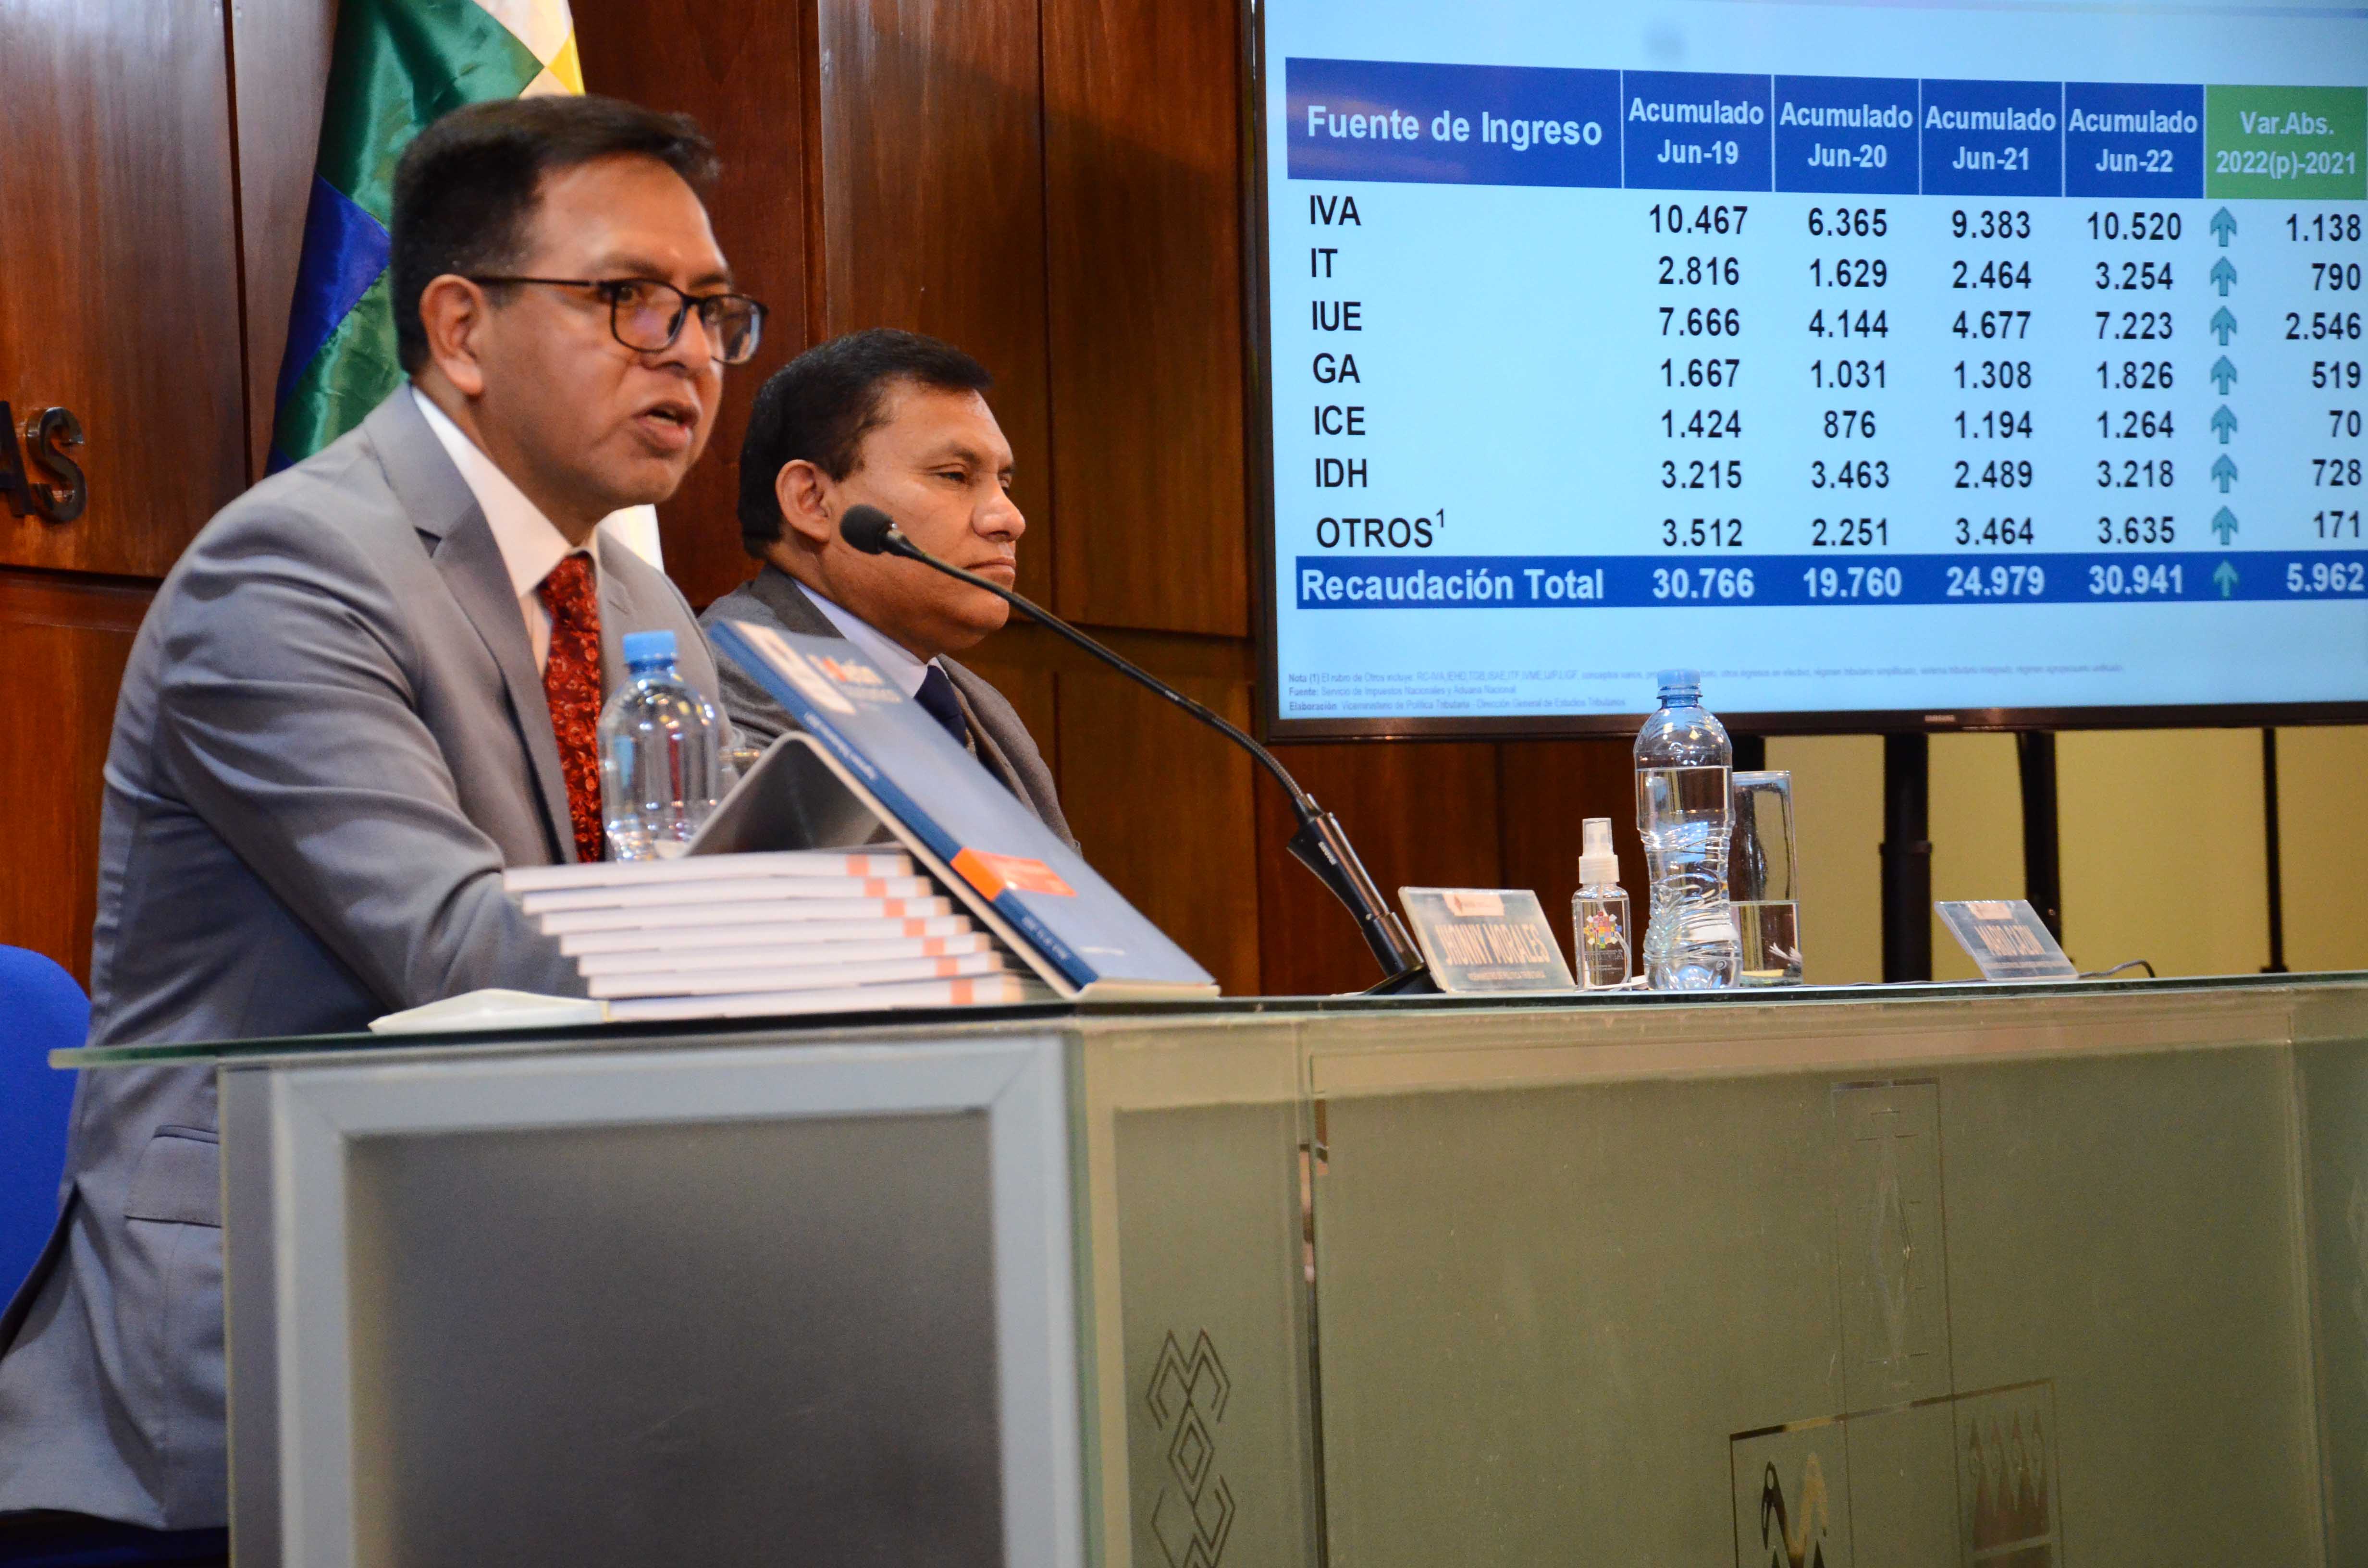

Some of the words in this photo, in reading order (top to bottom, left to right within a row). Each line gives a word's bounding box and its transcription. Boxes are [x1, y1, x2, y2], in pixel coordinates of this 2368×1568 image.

[1628, 97, 1765, 125] Acumulado
[1779, 101, 1913, 129] Acumulado
[1924, 105, 2057, 132] Acumulado
[2068, 108, 2198, 134] Acumulado
[1307, 105, 1420, 141] Fuente
[1431, 110, 1470, 142] de
[1481, 110, 1603, 152] Ingreso
[1657, 138, 1739, 165] Jun-19
[1807, 143, 1887, 169] Jun-20
[1952, 146, 2029, 171] Jun-21
[2095, 148, 2174, 173] Jun-22
[2215, 149, 2355, 180] 2022(p)-2021
[1309, 195, 1362, 227] IVA
[1649, 203, 1748, 235] 10.467
[1808, 207, 1887, 238] 6.365
[1951, 209, 2031, 240] 9.383
[2087, 211, 2182, 241] 10.520
[2286, 213, 2362, 242] 1.138
[1311, 247, 1339, 278] IT
[1658, 255, 1740, 286] 2.816
[1810, 257, 1887, 288] 1.629
[1952, 259, 2032, 290] 2.464
[2096, 261, 2174, 291] 3.254
[2311, 262, 2361, 292] 790
[1312, 300, 1362, 332] IUE
[1659, 306, 1740, 337] 7.666
[1808, 308, 1889, 339] 4.144
[1952, 310, 2031, 340] 4.677
[2096, 311, 2173, 340] 7.223
[2285, 311, 2362, 341] 2.546
[1312, 352, 1361, 384] GA
[1661, 357, 1740, 388] 1.667
[1811, 359, 1885, 389] 1.031
[1954, 360, 2032, 389] 1.308
[2097, 360, 2174, 390] 1.826
[2312, 360, 2361, 389] 519
[1314, 404, 1366, 436] ICE
[1661, 409, 1742, 439] 1.424
[1824, 409, 1876, 439] 876
[1955, 410, 2033, 439] 1.194
[2097, 410, 2175, 439] 1.264
[2329, 409, 2362, 438] 70
[1315, 457, 1368, 488] IDH
[1661, 460, 1742, 489] 3.215
[1811, 460, 1890, 489] 3.463
[1954, 460, 2033, 489] 2.489
[2097, 459, 2174, 488] 3.218
[2312, 458, 2362, 487] 728
[1663, 518, 1743, 547] 3.512
[1812, 517, 1887, 547] 2.251
[1956, 517, 2035, 546] 3.464
[2097, 515, 2175, 545] 3.635
[2313, 510, 2360, 539] 171
[1302, 567, 1514, 601] Recaudación
[1523, 568, 1604, 600] Total
[1652, 567, 1755, 599] 30.766
[1803, 566, 1902, 598] 19.760
[1946, 565, 2045, 597] 24.979
[2088, 564, 2183, 595] 30.941
[2286, 562, 2365, 593] 5.962
[1288, 674, 1307, 682] Nota
